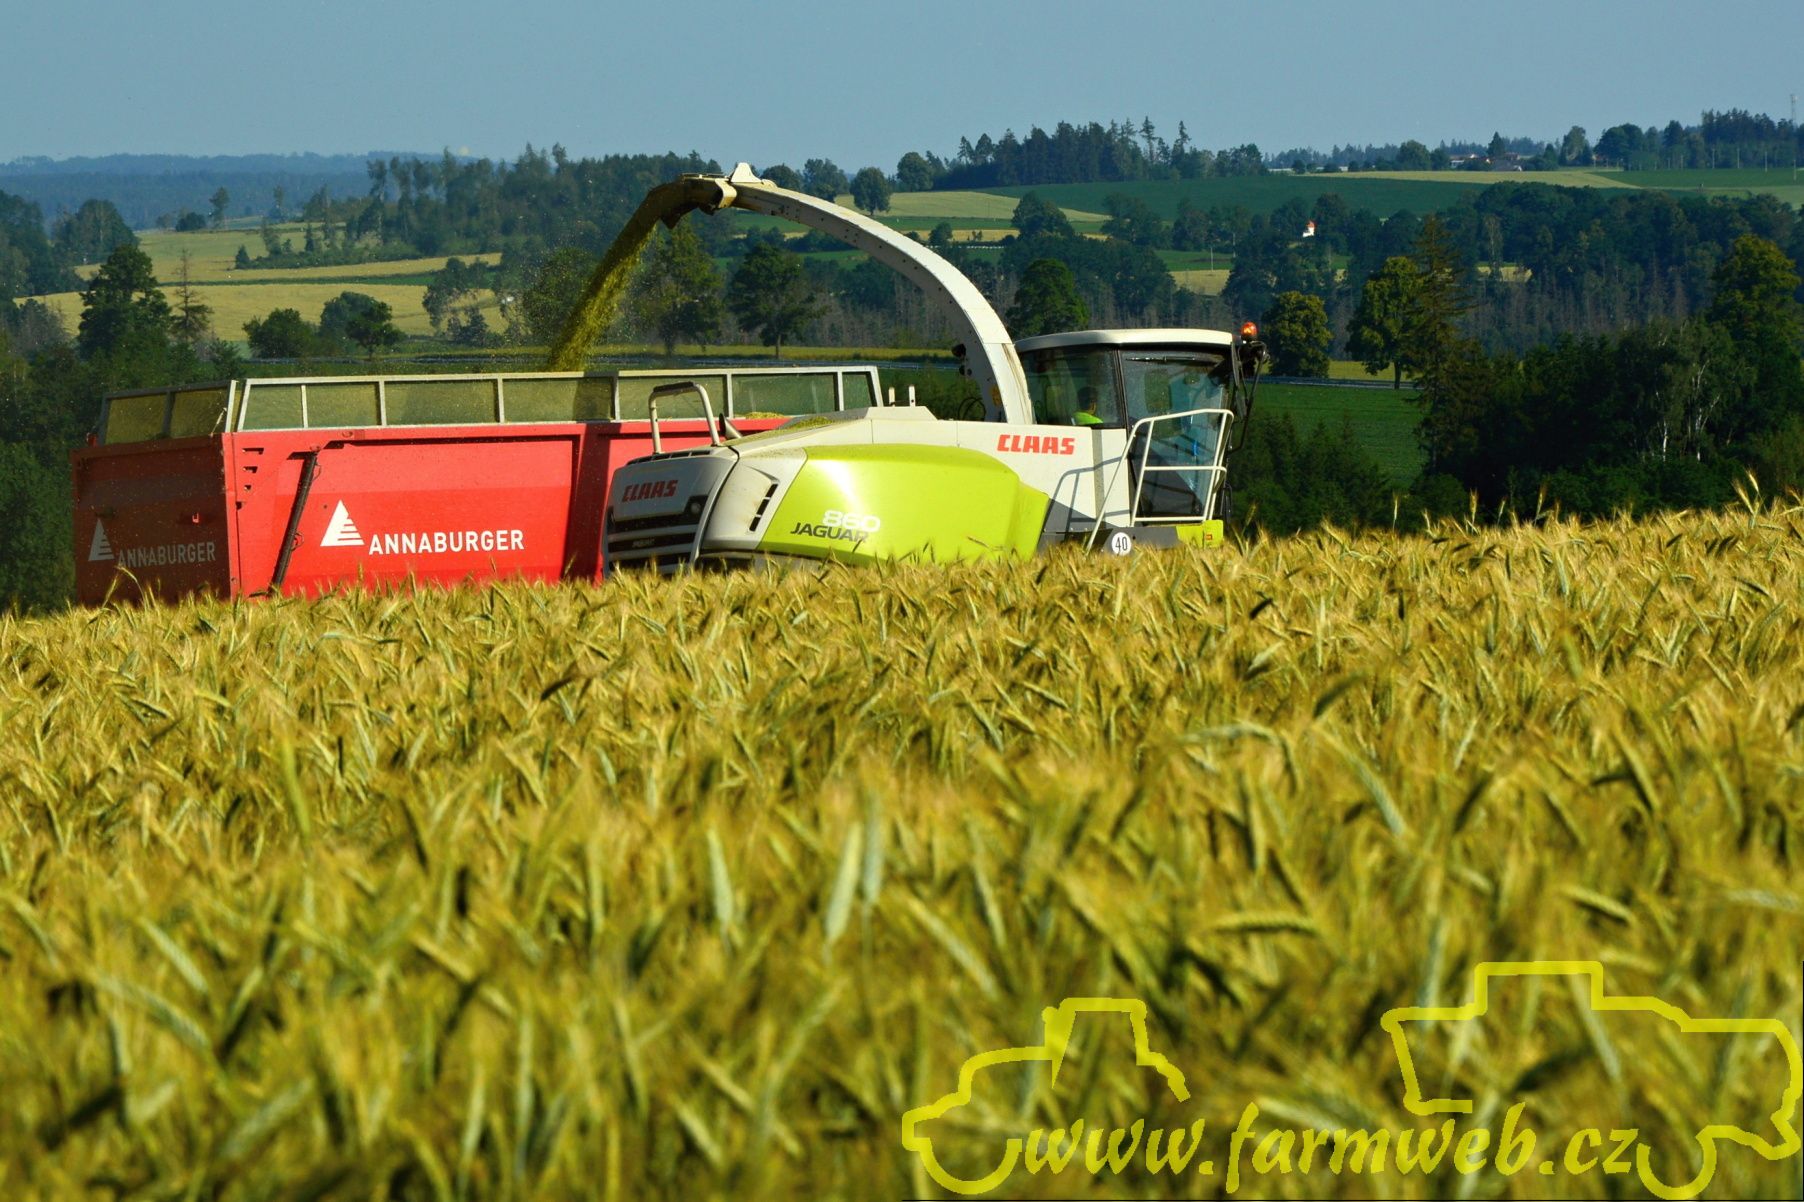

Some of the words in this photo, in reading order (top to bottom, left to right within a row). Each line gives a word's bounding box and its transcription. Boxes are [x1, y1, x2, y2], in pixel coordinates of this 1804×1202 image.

[997, 434, 1076, 456] CLAAS
[622, 479, 679, 503] CLAAS
[790, 522, 869, 543] JAGUAR
[822, 509, 881, 533] 860
[368, 529, 525, 556] ANNABURGER
[1114, 536, 1128, 552] 40
[118, 541, 217, 569] ANNABURGER
